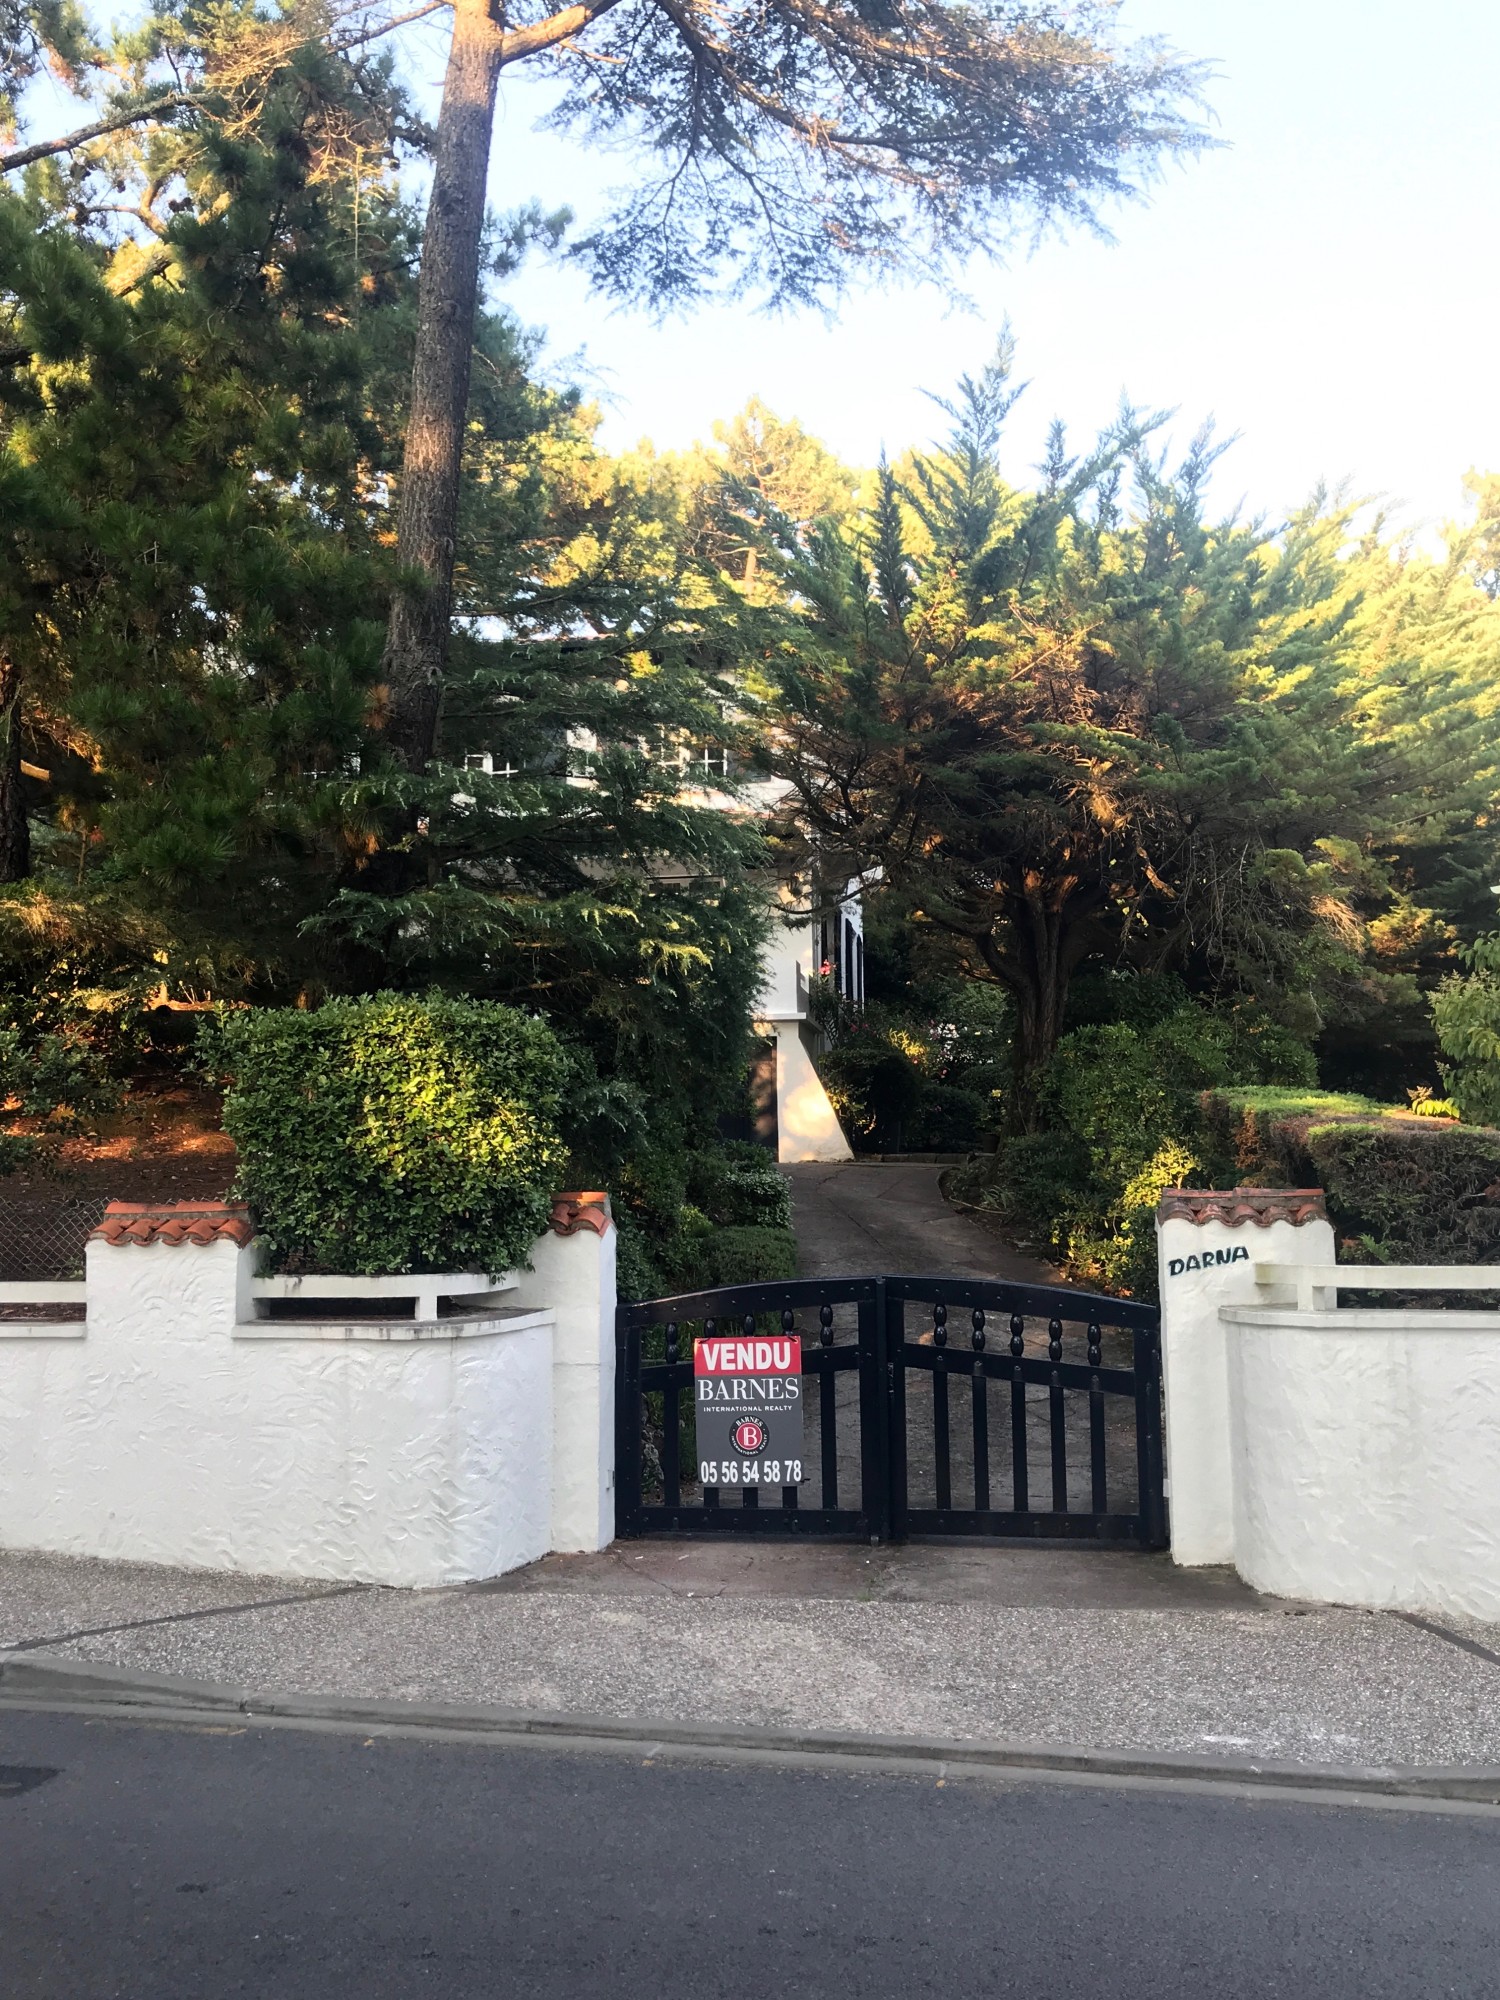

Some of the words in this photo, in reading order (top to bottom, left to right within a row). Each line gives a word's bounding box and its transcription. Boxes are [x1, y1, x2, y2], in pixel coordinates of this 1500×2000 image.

[1168, 1246, 1249, 1276] DARNA
[702, 1342, 791, 1371] VENDU
[698, 1377, 799, 1401] BARNES
[735, 1416, 763, 1427] BARNES
[743, 1426, 758, 1446] B
[701, 1461, 718, 1483] 05
[721, 1461, 738, 1483] 56
[742, 1460, 760, 1483] 54
[763, 1460, 781, 1483] 58
[784, 1459, 802, 1482] 78
